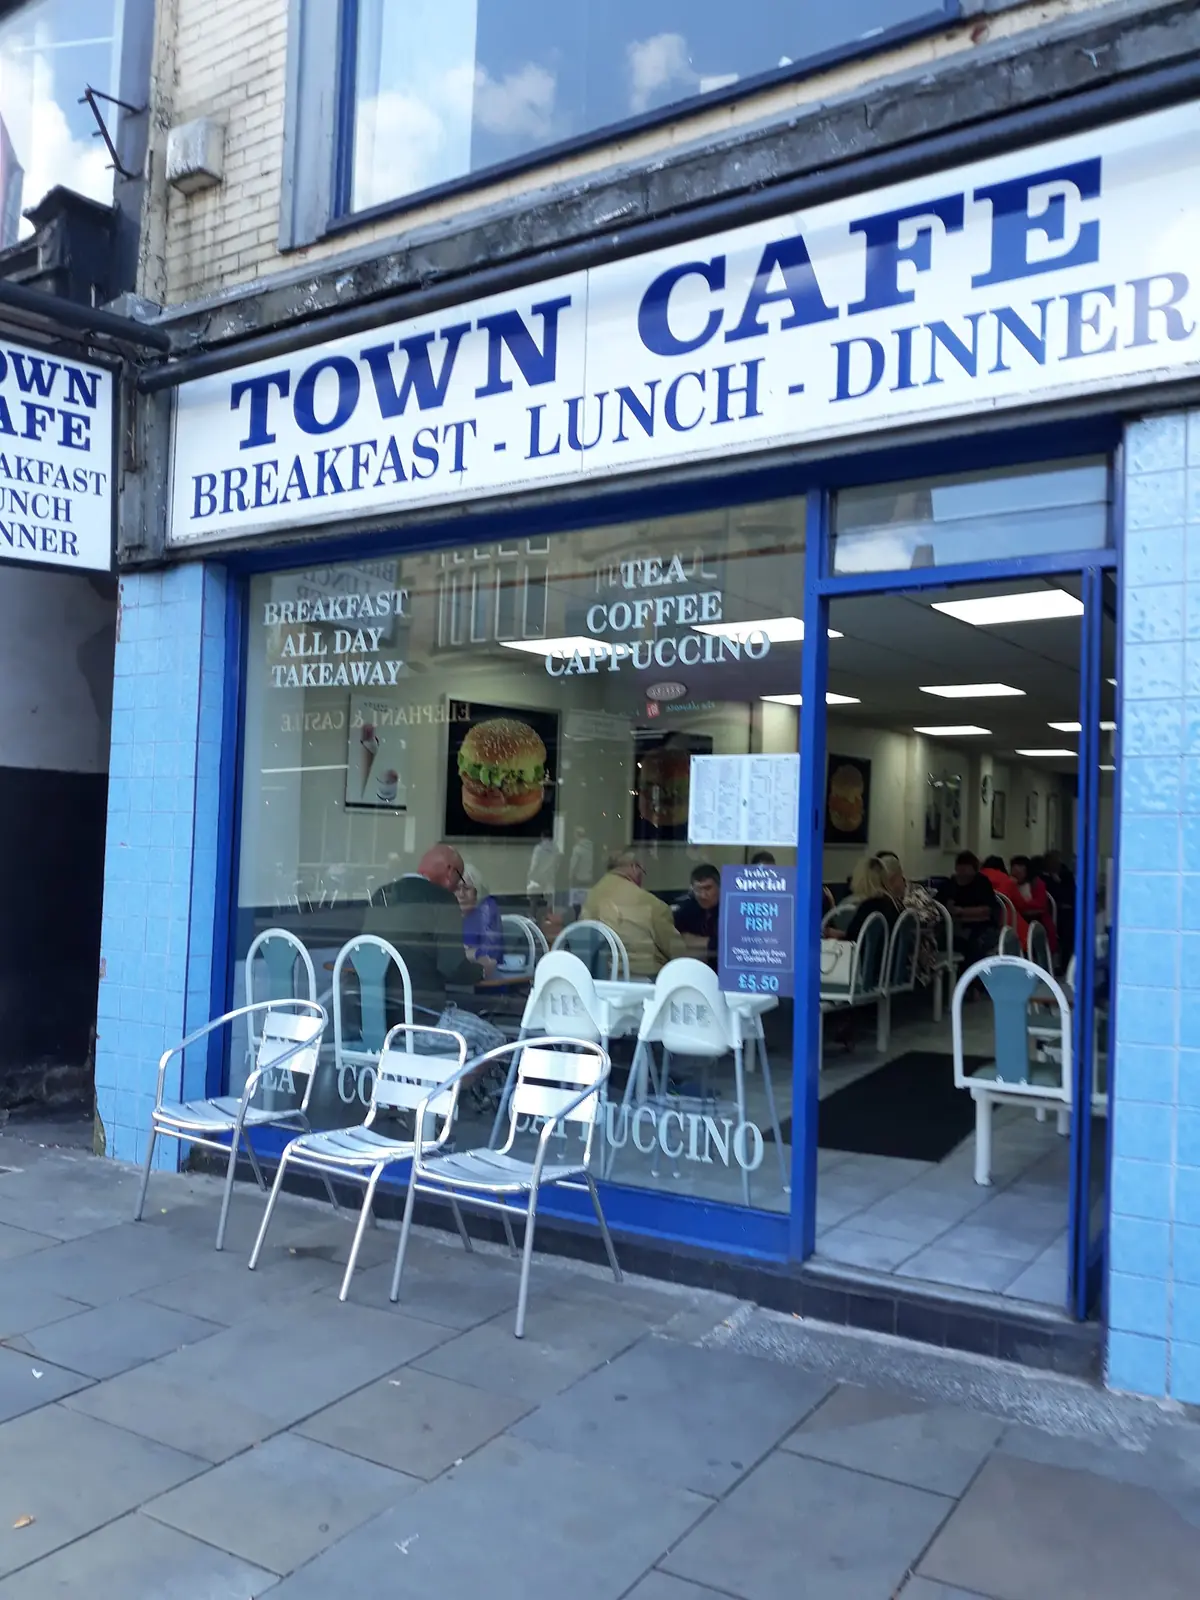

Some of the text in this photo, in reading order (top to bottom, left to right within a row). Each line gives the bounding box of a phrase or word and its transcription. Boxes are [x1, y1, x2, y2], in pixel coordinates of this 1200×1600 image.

[230, 156, 1102, 451] TOWN CAFE
[0, 350, 102, 409] WN
[190, 419, 477, 520] BREAKFAST
[524, 358, 766, 460] LUNCH
[829, 271, 1197, 402] DINNER
[0, 452, 107, 497] AKFAST
[0, 485, 73, 524] NCH
[0, 520, 80, 558] NNER
[621, 555, 689, 590] TEA
[263, 589, 409, 626] BREAKFAST
[586, 591, 723, 634] COFFEE
[280, 627, 385, 658] ALL DAY
[544, 629, 771, 677] CAPPUCCINO
[271, 660, 404, 688] TAKEAWAY
[739, 902, 779, 917] FRESH
[745, 918, 773, 932] FISH
[738, 973, 780, 992] £5.50
